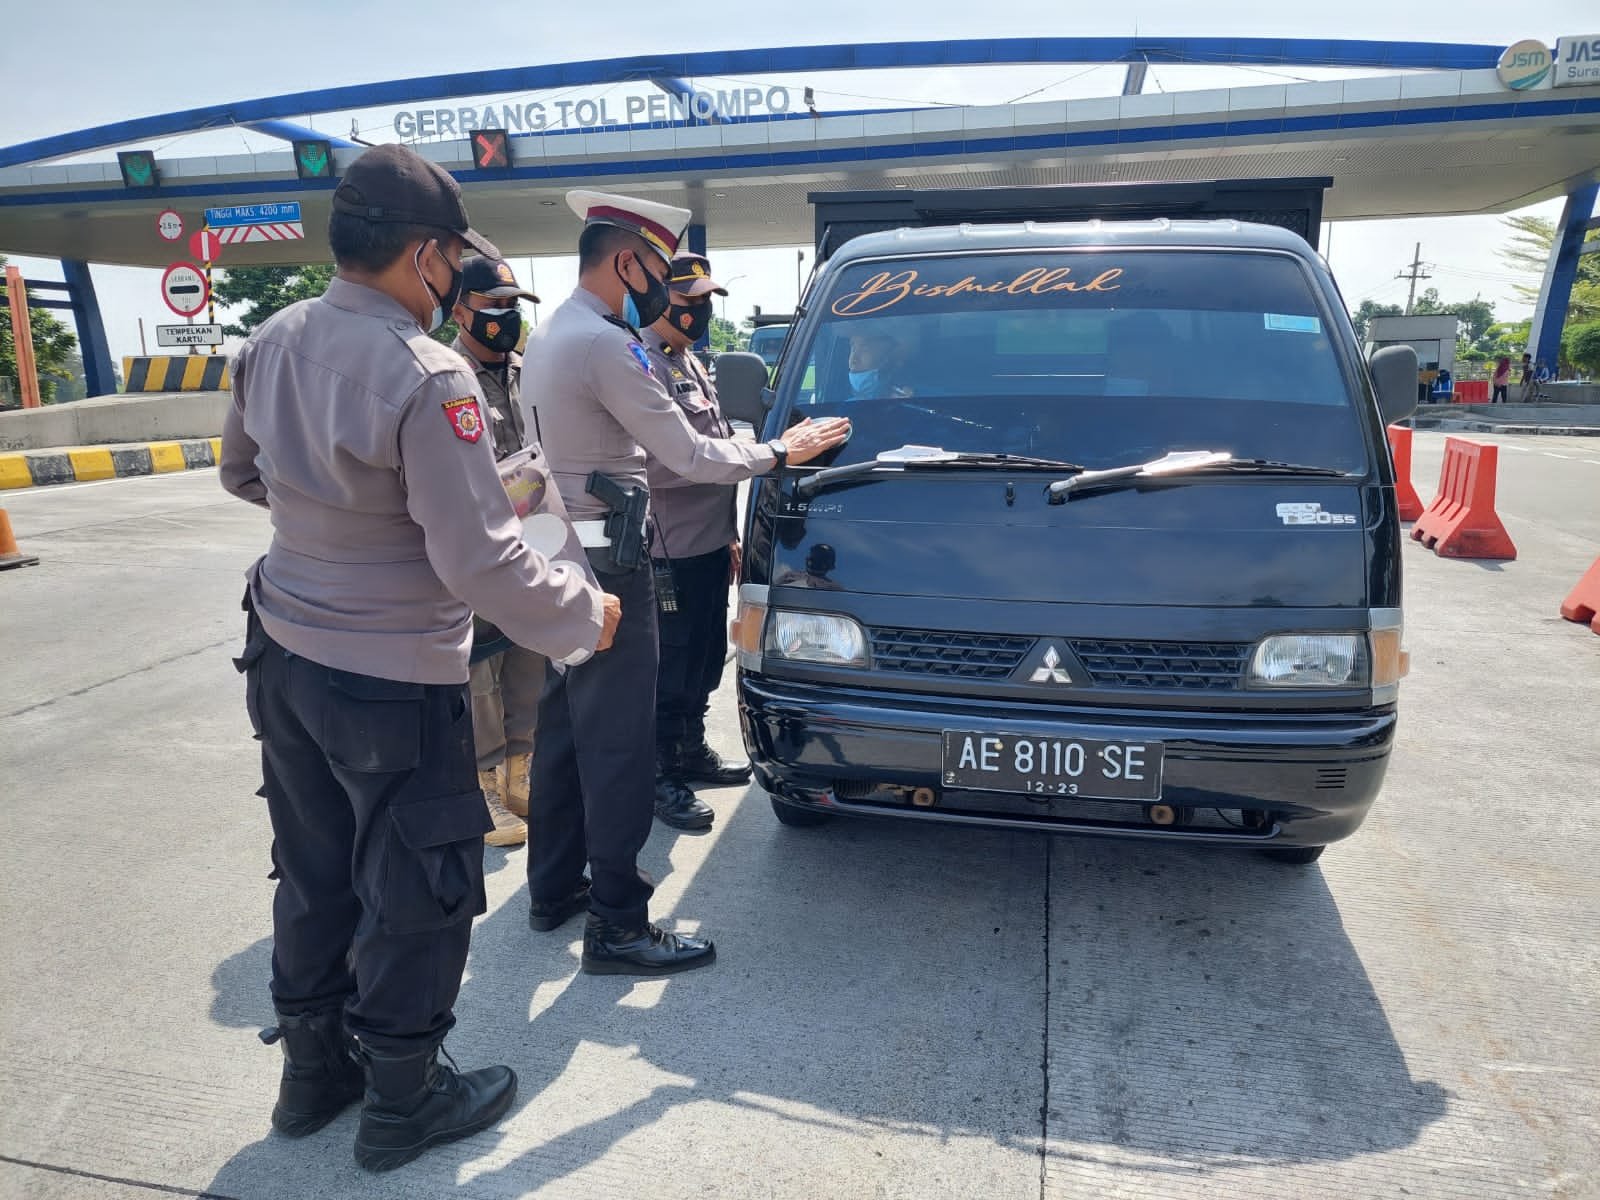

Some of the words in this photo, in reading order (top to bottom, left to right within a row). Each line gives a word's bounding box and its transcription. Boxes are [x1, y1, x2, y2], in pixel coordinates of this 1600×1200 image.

[393, 102, 547, 137] GERBANG
[554, 98, 618, 128] TOL
[625, 86, 790, 123] PENOMPO
[260, 205, 278, 216] 4200
[166, 327, 213, 336] TEMPELKAN
[958, 736, 1000, 771] AE
[1014, 740, 1085, 777] 8110
[1101, 745, 1146, 780] SE
